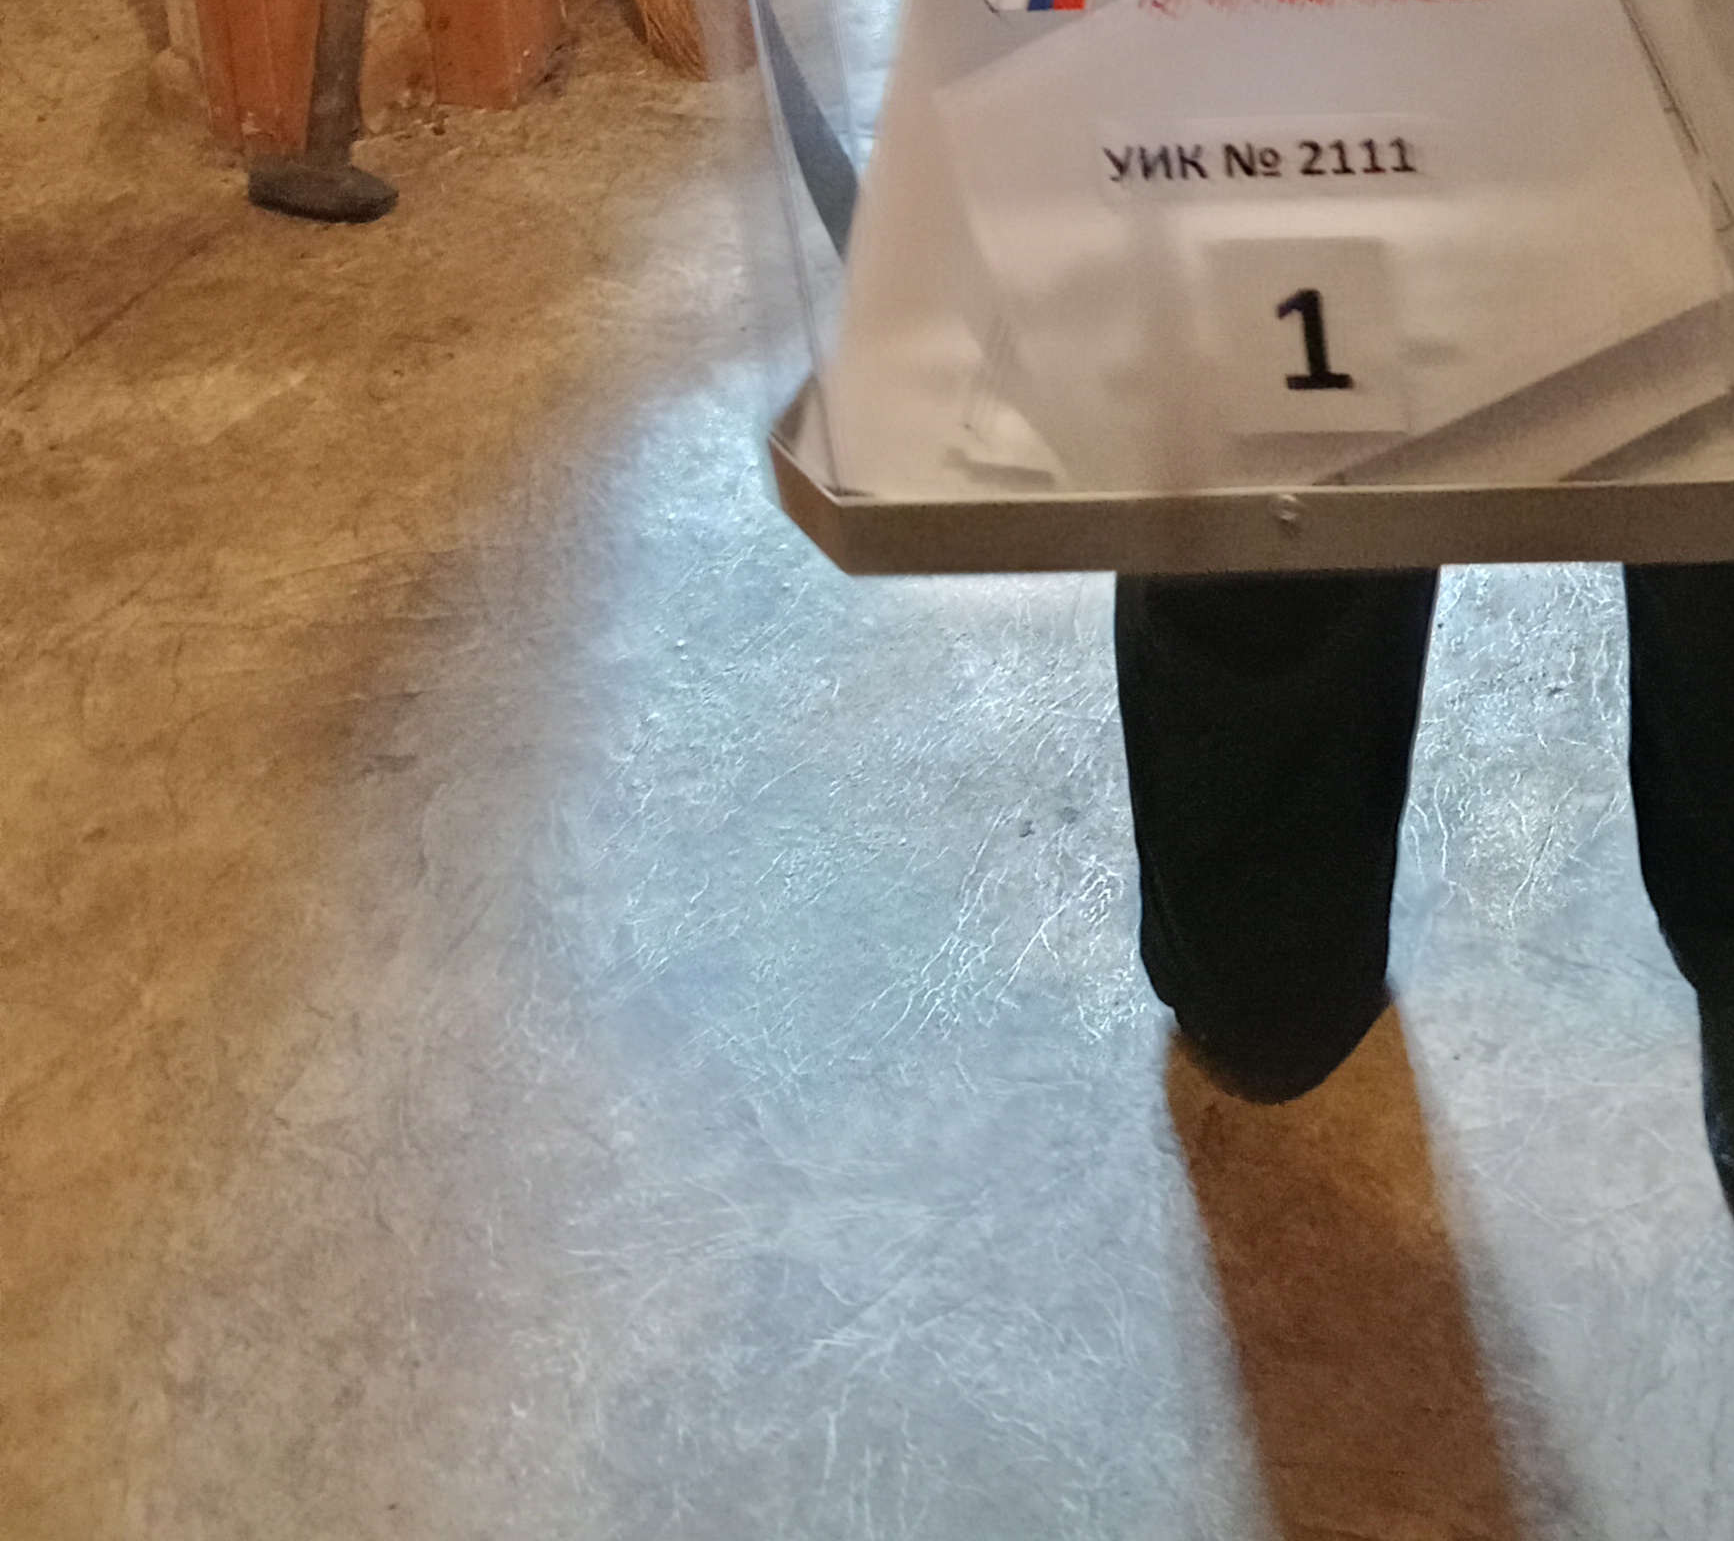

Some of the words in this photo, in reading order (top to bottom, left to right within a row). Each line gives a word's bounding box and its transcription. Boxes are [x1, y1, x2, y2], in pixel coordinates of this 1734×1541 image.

[1102, 143, 1209, 183] УИК
[1222, 141, 1283, 179] №
[1298, 137, 1418, 177] 2111
[1276, 288, 1354, 390] 1
